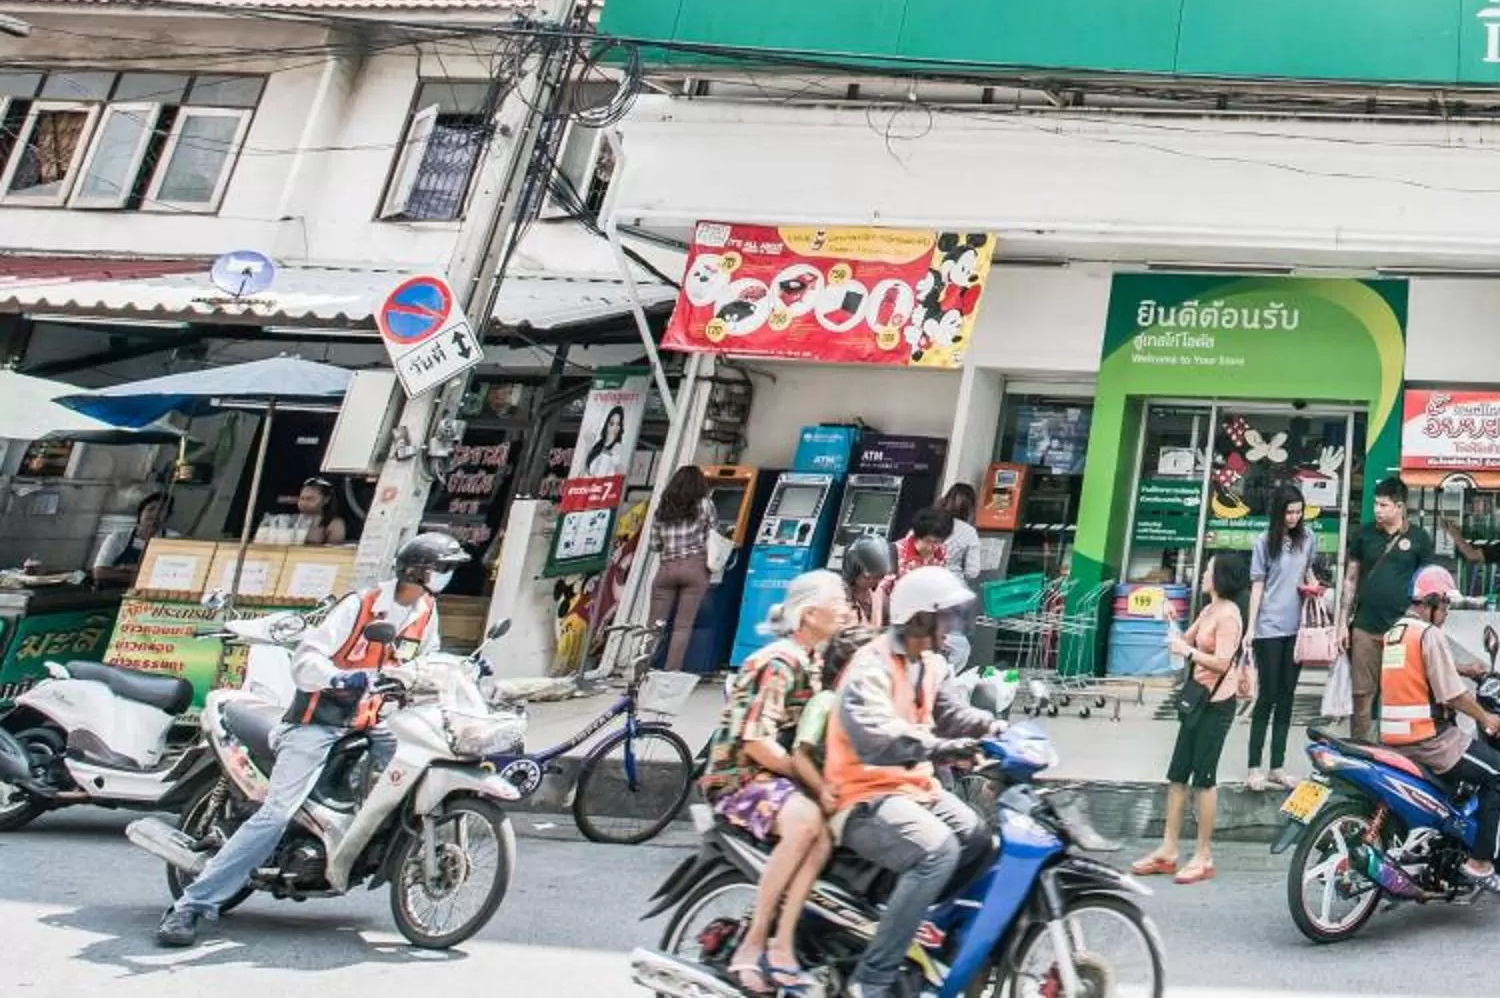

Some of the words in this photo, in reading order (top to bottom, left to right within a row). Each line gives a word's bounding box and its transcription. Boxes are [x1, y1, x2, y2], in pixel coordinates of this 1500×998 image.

[1136, 299, 1300, 331] ยินดีต้อนรับ
[409, 340, 447, 375] วันที่
[601, 482, 613, 502] 7
